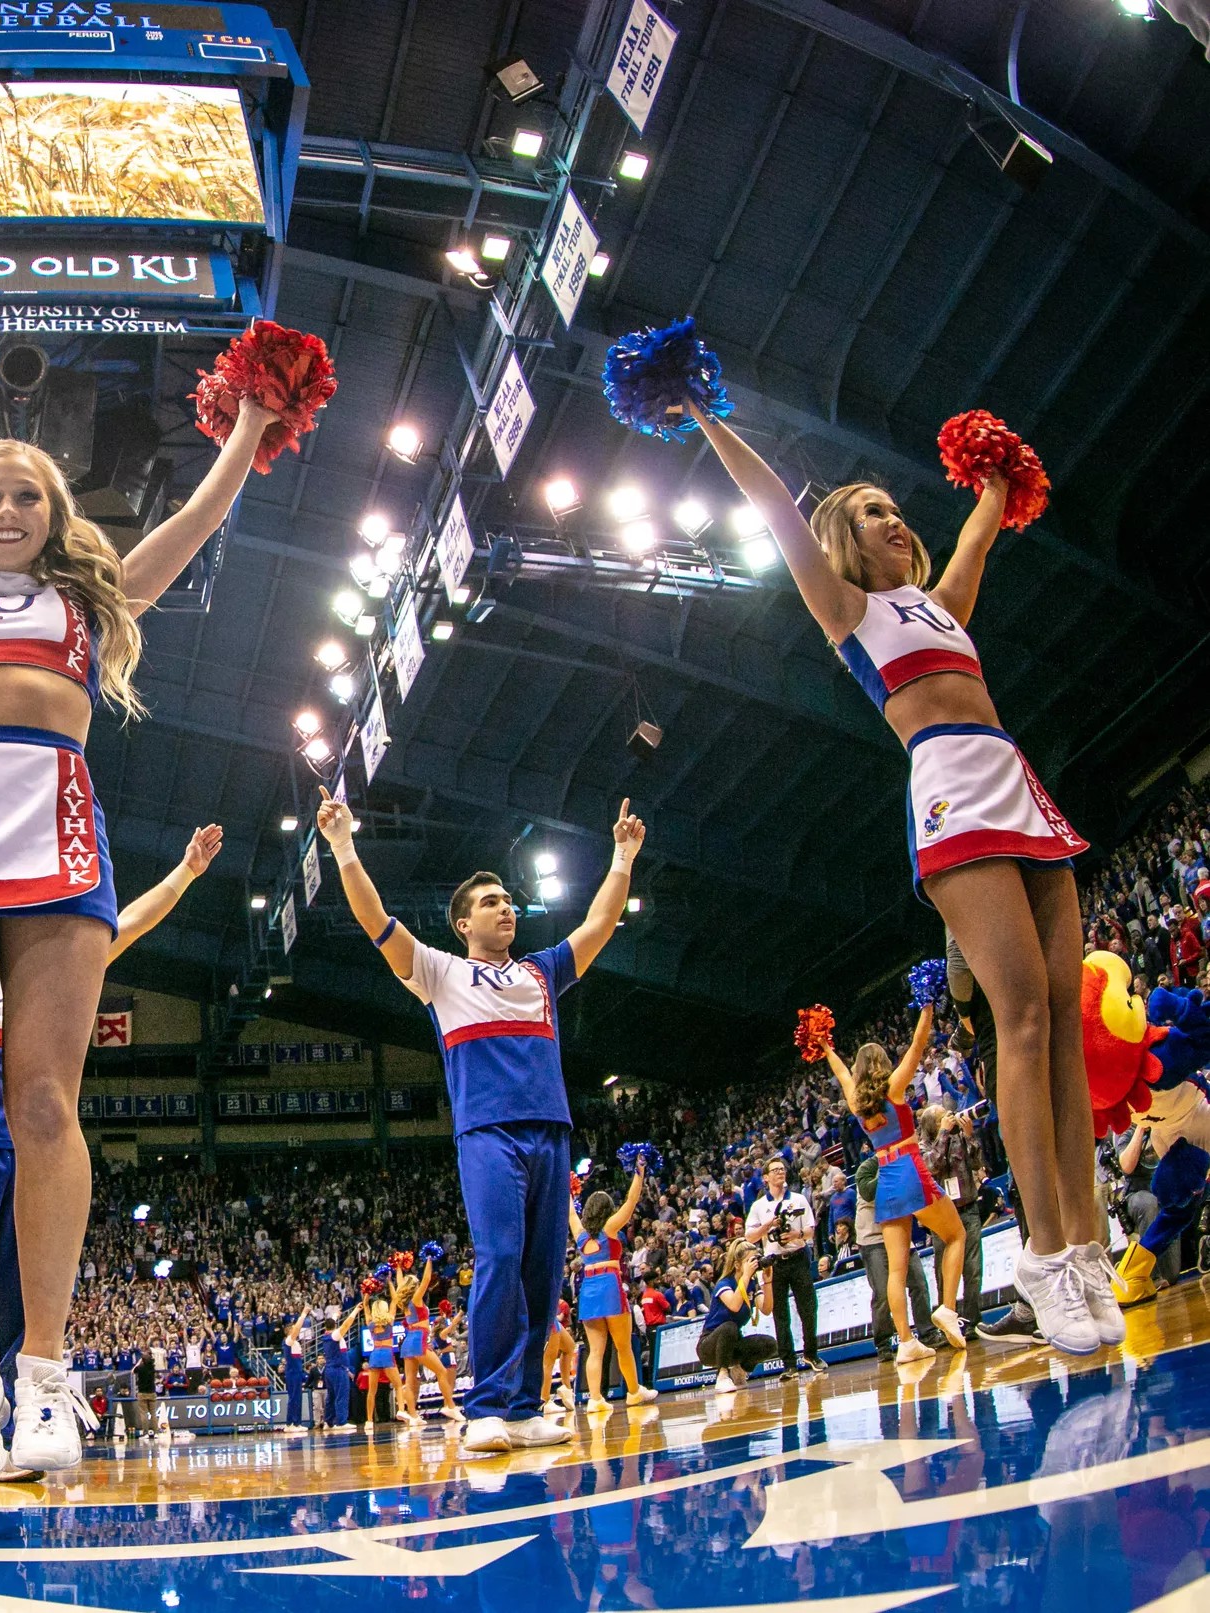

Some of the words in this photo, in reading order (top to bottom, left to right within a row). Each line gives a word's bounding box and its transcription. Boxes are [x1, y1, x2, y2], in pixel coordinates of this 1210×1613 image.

[202, 34, 252, 44] TCU
[617, 21, 640, 76] NCAA
[620, 54, 642, 105] FINAL
[636, 12, 657, 57] FOUR
[640, 51, 661, 98] 1991
[552, 217, 570, 269] NCAA
[553, 251, 570, 298] FINAL
[567, 214, 583, 255] FOUR
[31, 256, 120, 277] OLD
[128, 254, 198, 284] KU
[568, 250, 587, 299] 1988
[2, 317, 95, 332] HEALTH
[101, 318, 188, 333] SYSTEM
[111, 306, 140, 318] OF
[492, 408, 509, 448] FINAL
[507, 376, 523, 414] FOUR
[493, 377, 511, 420] NCAA
[60, 753, 97, 885] JAYHAWK
[1025, 766, 1082, 847] AYHAWK
[98, 1015, 127, 1045] K
[674, 1376, 694, 1386] ROCKET
[694, 1373, 716, 1384] Mortgage
[763, 1359, 785, 1371] ROCKE
[186, 1404, 207, 1419] TO
[252, 1400, 281, 1419] KU
